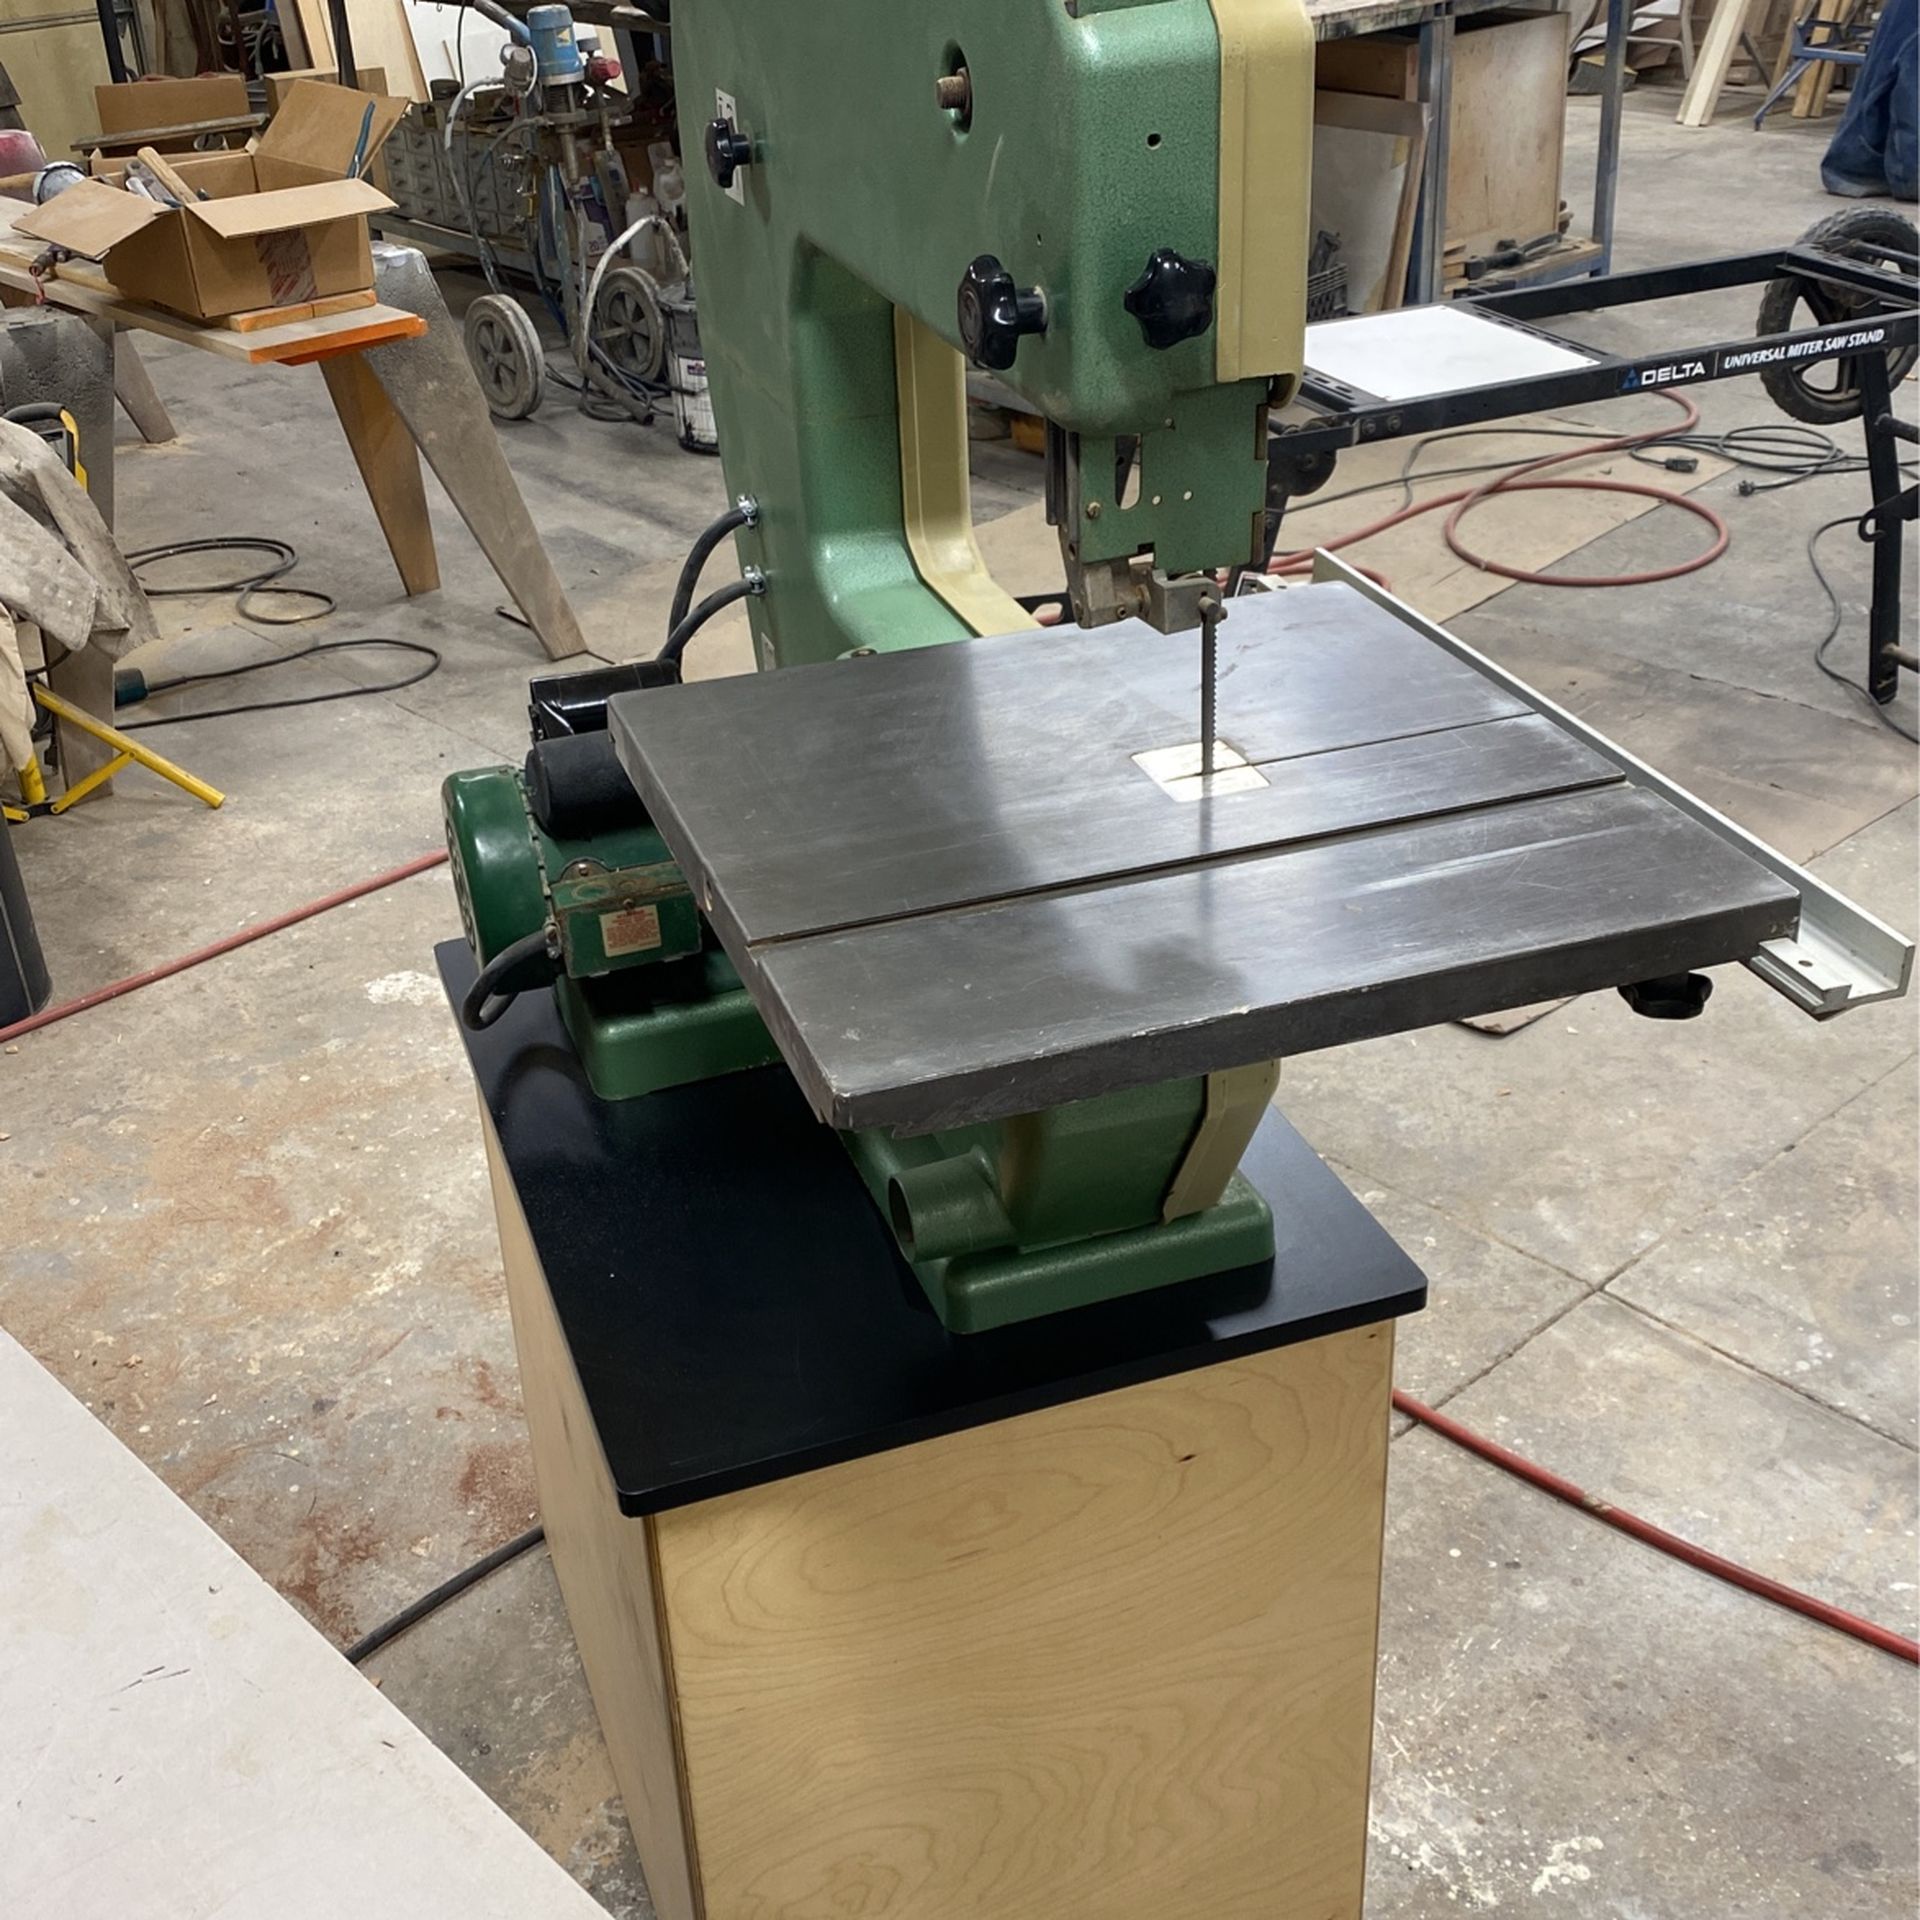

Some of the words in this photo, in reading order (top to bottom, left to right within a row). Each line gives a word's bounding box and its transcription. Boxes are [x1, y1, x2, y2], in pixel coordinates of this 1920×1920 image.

[1724, 346, 1786, 369] UNIVERSAL
[1787, 340, 1823, 358] MITER
[1823, 336, 1849, 351] SAW
[1849, 328, 1885, 347] STAND
[1641, 361, 1706, 385] DELTA
